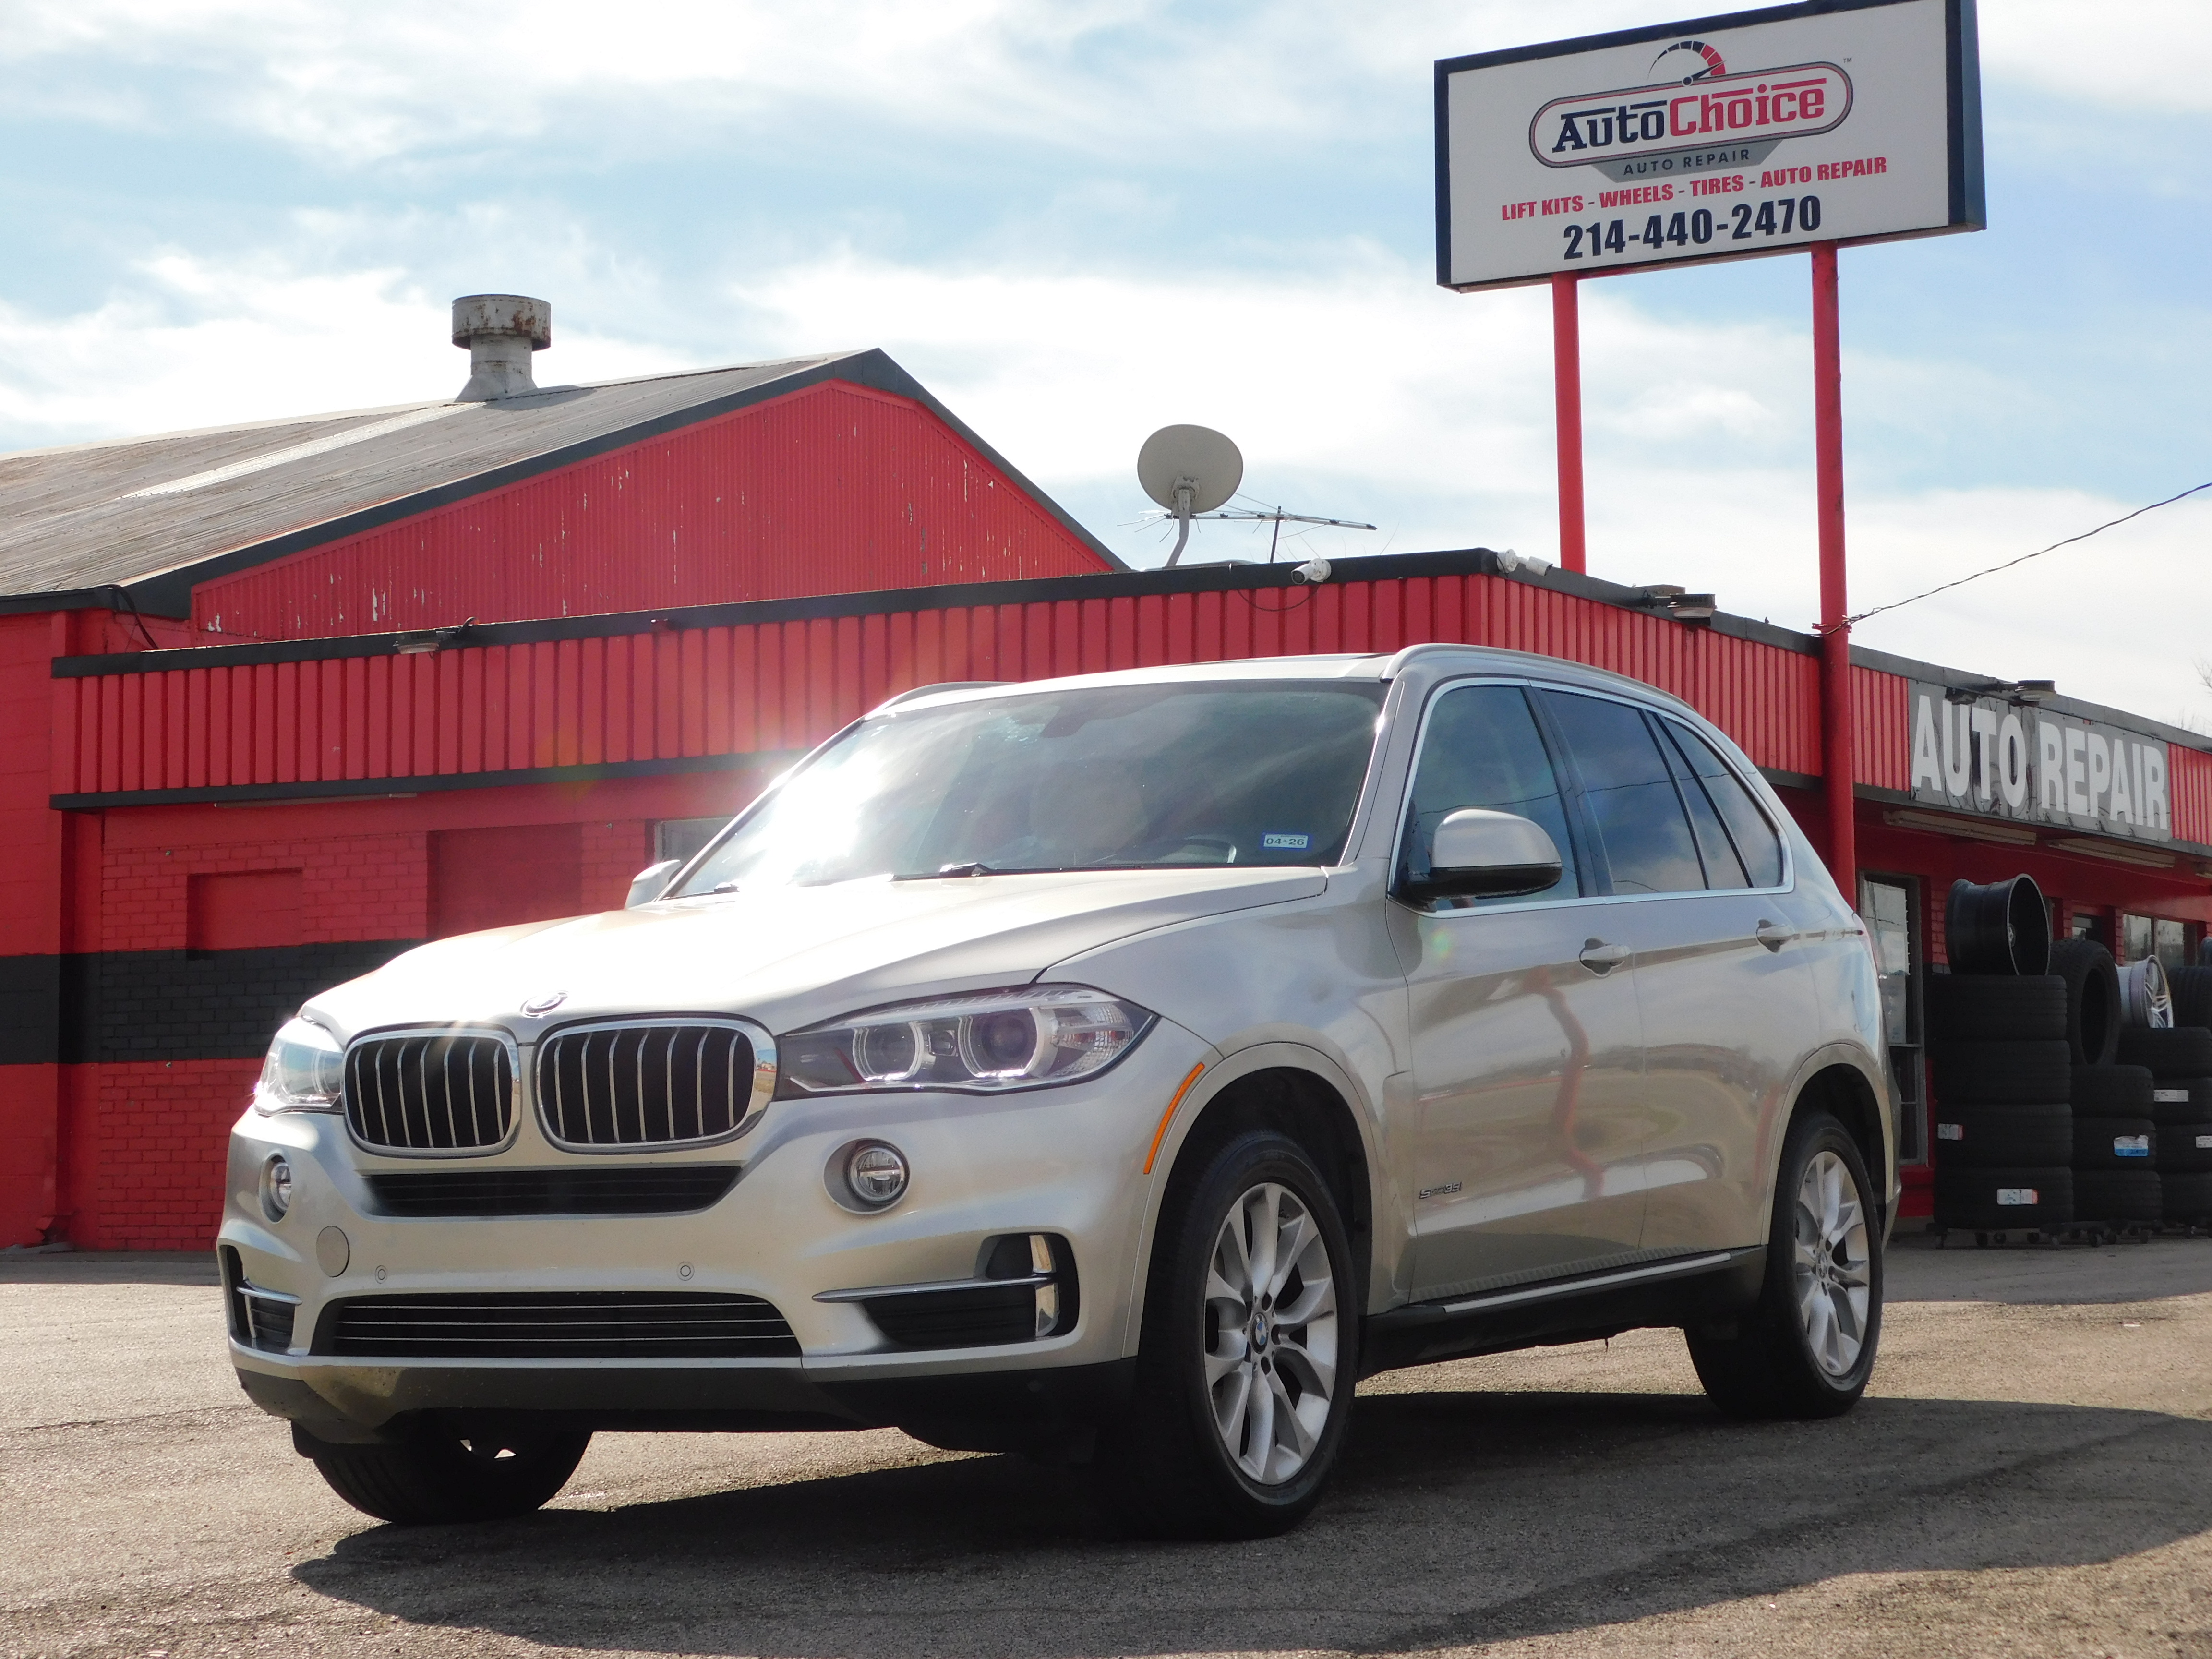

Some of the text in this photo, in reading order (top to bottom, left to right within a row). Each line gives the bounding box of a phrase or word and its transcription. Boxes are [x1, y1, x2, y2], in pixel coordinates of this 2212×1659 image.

[1552, 78, 1827, 153] AutoChoice
[1502, 201, 1537, 221] LIFT
[1541, 195, 1584, 216] KITS
[1599, 184, 1674, 208] WHEELS
[1690, 175, 1744, 196] TIRES
[1760, 166, 1812, 188] AUTO
[1817, 156, 1887, 181] REPAIR
[1623, 149, 1750, 176] AUTO REPAIR
[1563, 195, 1821, 260] 214-440-2470
[1912, 695, 2168, 830] AUTO REPAIR
